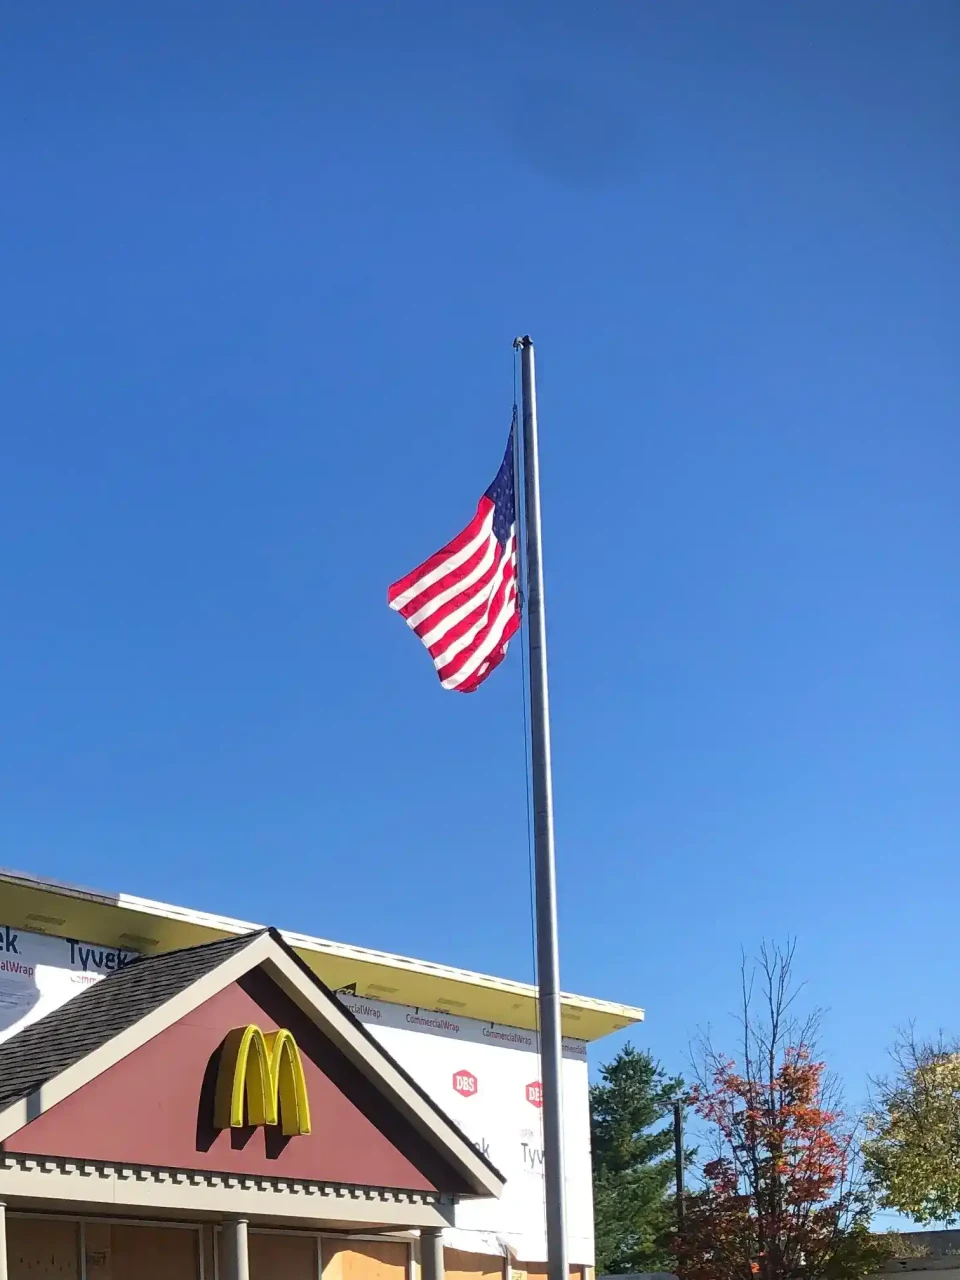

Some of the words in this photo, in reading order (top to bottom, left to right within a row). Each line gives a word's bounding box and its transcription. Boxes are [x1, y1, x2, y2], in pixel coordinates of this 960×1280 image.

[66, 938, 128, 971] Tyvek
[406, 1013, 460, 1033] CommercialWrap
[483, 1027, 532, 1046] CommercialWrap
[455, 1075, 475, 1092] DBS
[520, 1142, 544, 1169] Tyv
